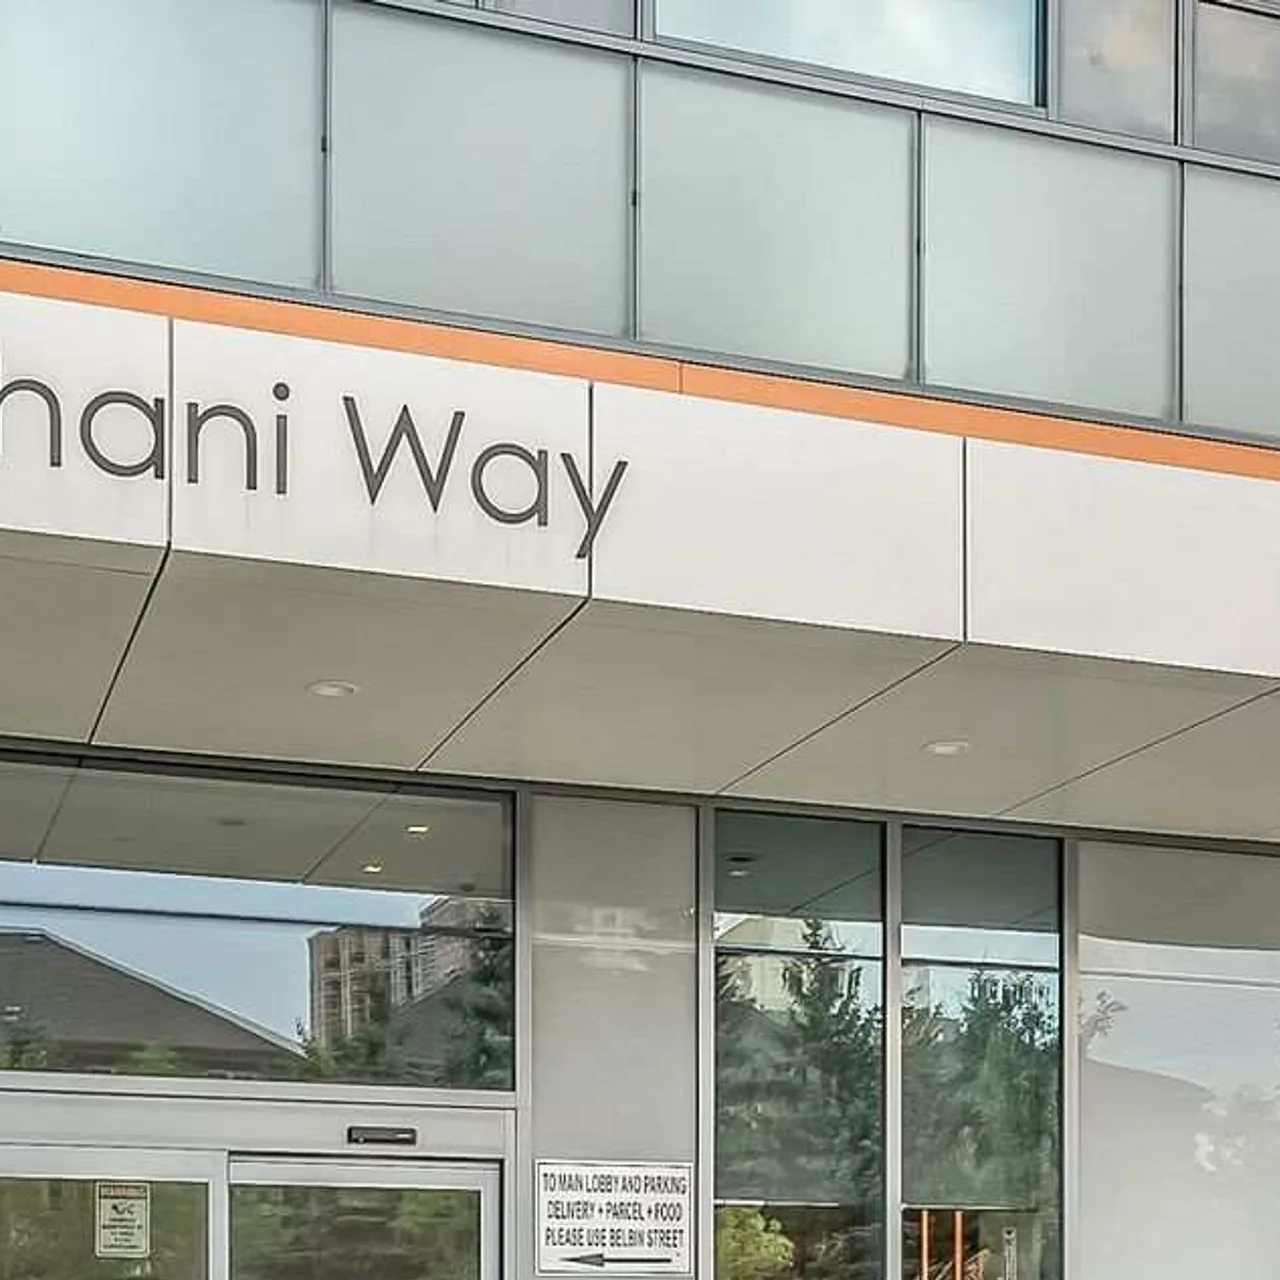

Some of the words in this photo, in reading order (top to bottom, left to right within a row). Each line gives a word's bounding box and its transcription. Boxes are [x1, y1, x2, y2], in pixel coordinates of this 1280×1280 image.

[342, 395, 629, 559] Way
[542, 1173, 556, 1191] TO
[559, 1174, 583, 1192] MAIN
[585, 1174, 619, 1193] LOBBY
[622, 1175, 641, 1193] AND
[644, 1175, 687, 1194] PARKING
[547, 1200, 596, 1220] DELIVERY
[606, 1201, 645, 1221] PARCEL
[654, 1202, 683, 1222] FOOD
[545, 1227, 584, 1246] PLEASE
[587, 1227, 606, 1246] USE
[609, 1228, 645, 1247] BELBIN
[646, 1228, 684, 1248] STREET
